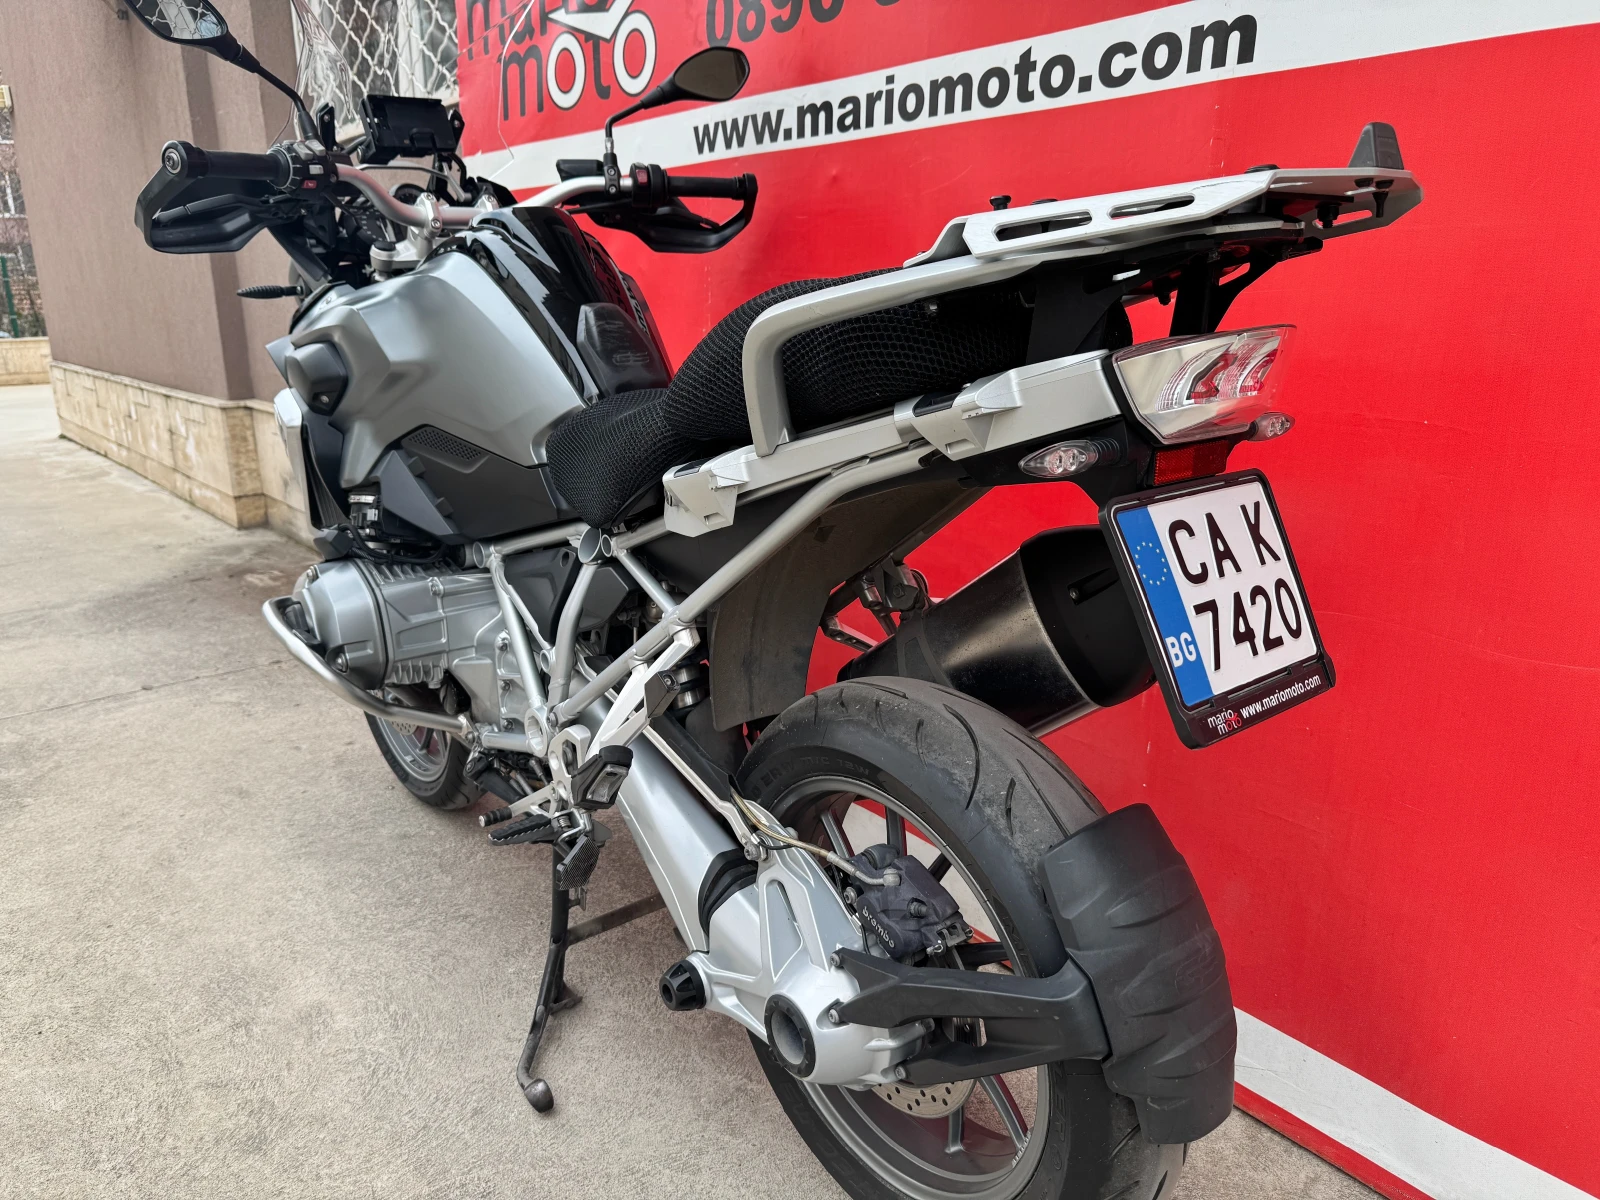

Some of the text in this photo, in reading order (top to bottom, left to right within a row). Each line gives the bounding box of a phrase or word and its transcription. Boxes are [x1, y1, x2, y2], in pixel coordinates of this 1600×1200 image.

[497, 10, 656, 121] moto
[693, 13, 1257, 155] www.mariomoto.com
[1168, 501, 1281, 584] CA K
[1165, 632, 1197, 668] BG
[1193, 578, 1302, 671] 7420
[1207, 708, 1235, 728] mario
[1240, 674, 1321, 719] www.mariomoto.com
[862, 906, 895, 948] brembo
